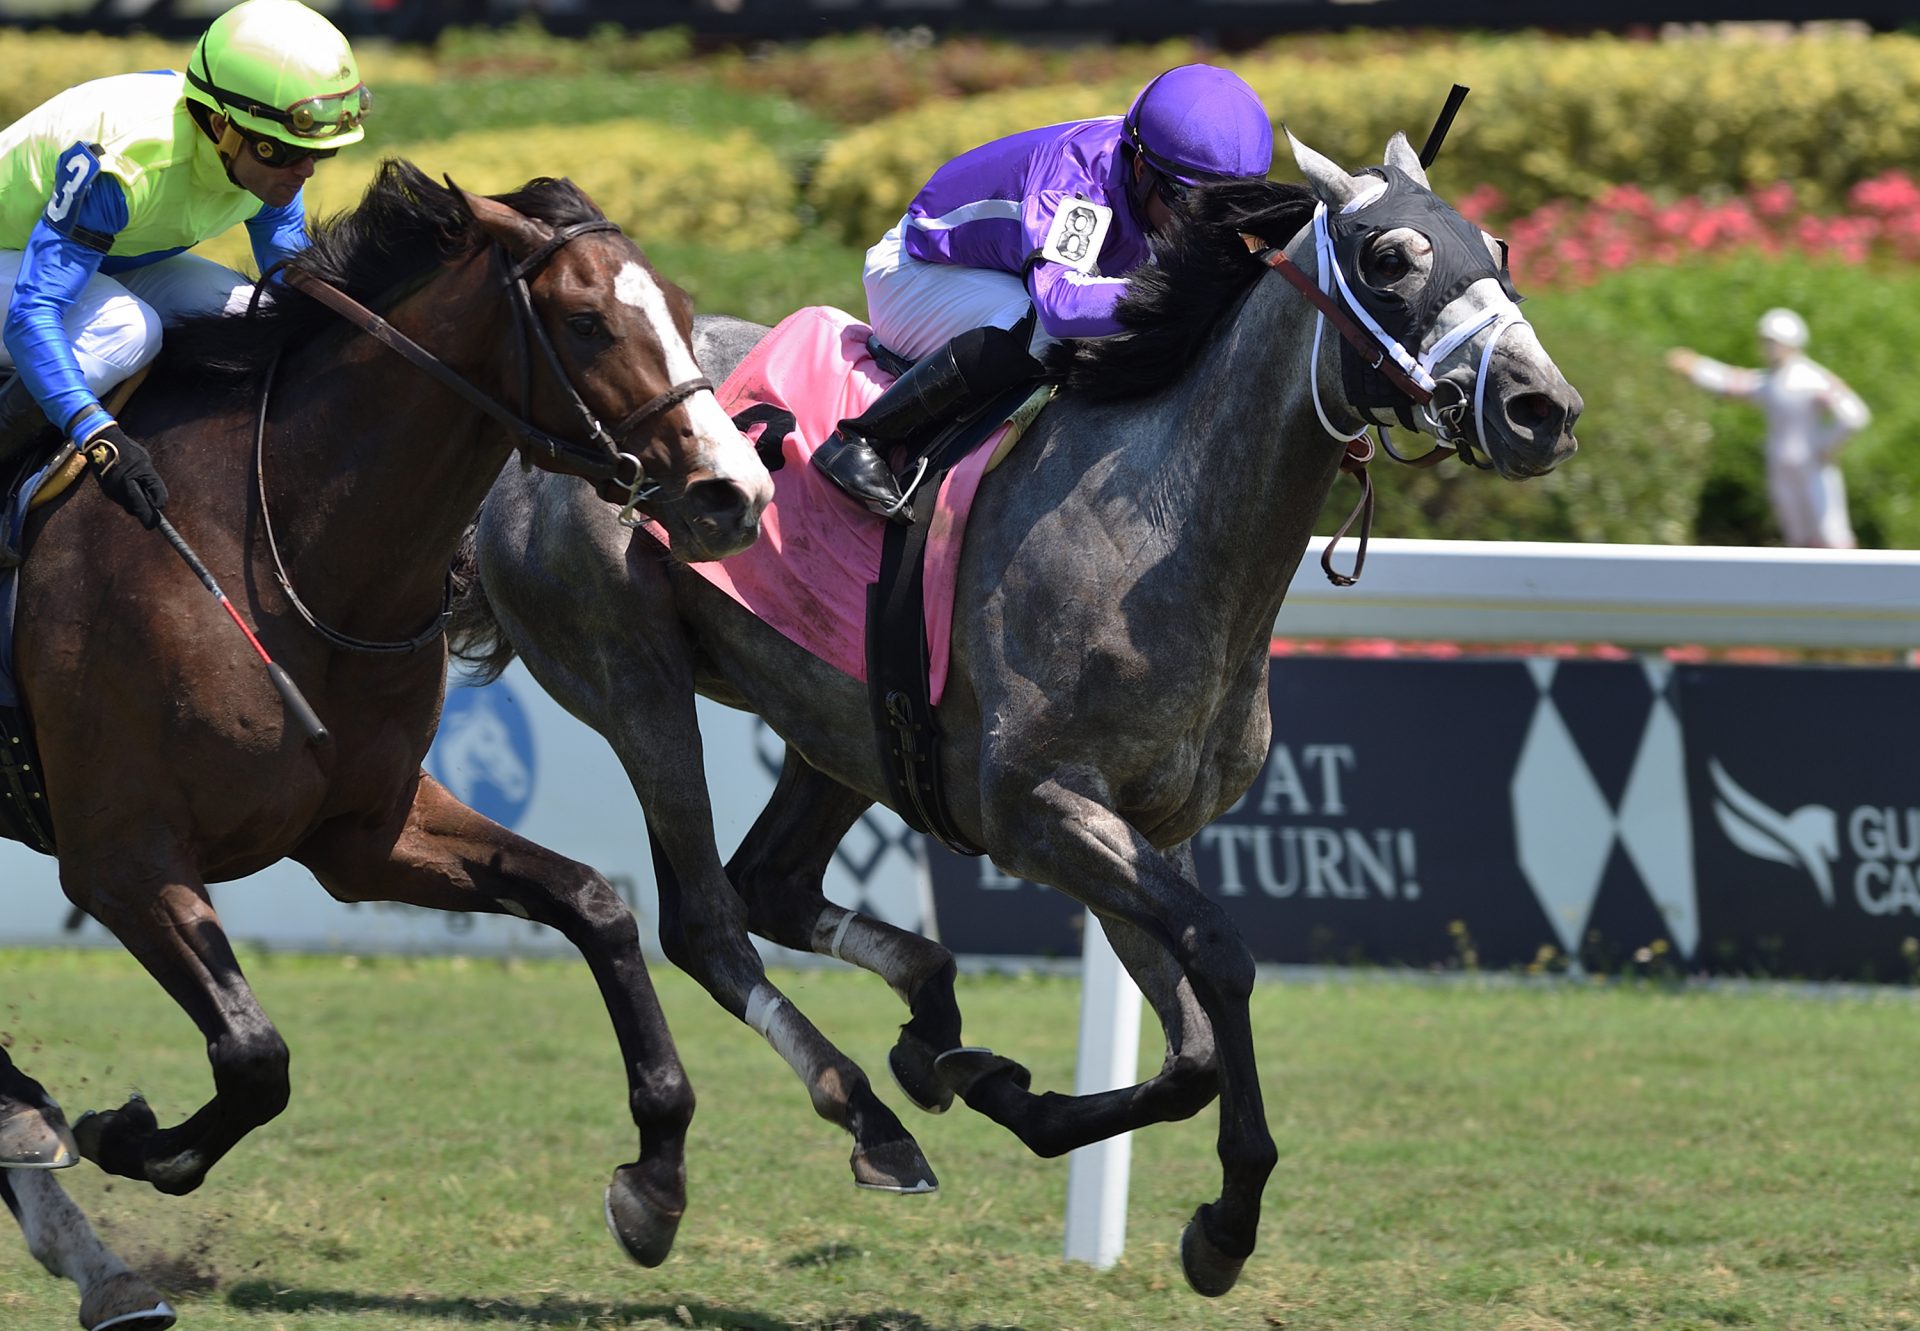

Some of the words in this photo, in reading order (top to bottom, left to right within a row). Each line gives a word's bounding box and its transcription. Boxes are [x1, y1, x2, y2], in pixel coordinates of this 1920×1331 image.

[46, 153, 91, 222] 3
[1056, 206, 1098, 262] 8
[1259, 742, 1356, 816] AT
[1202, 824, 1421, 900] TURN!
[1853, 861, 1920, 917] CA
